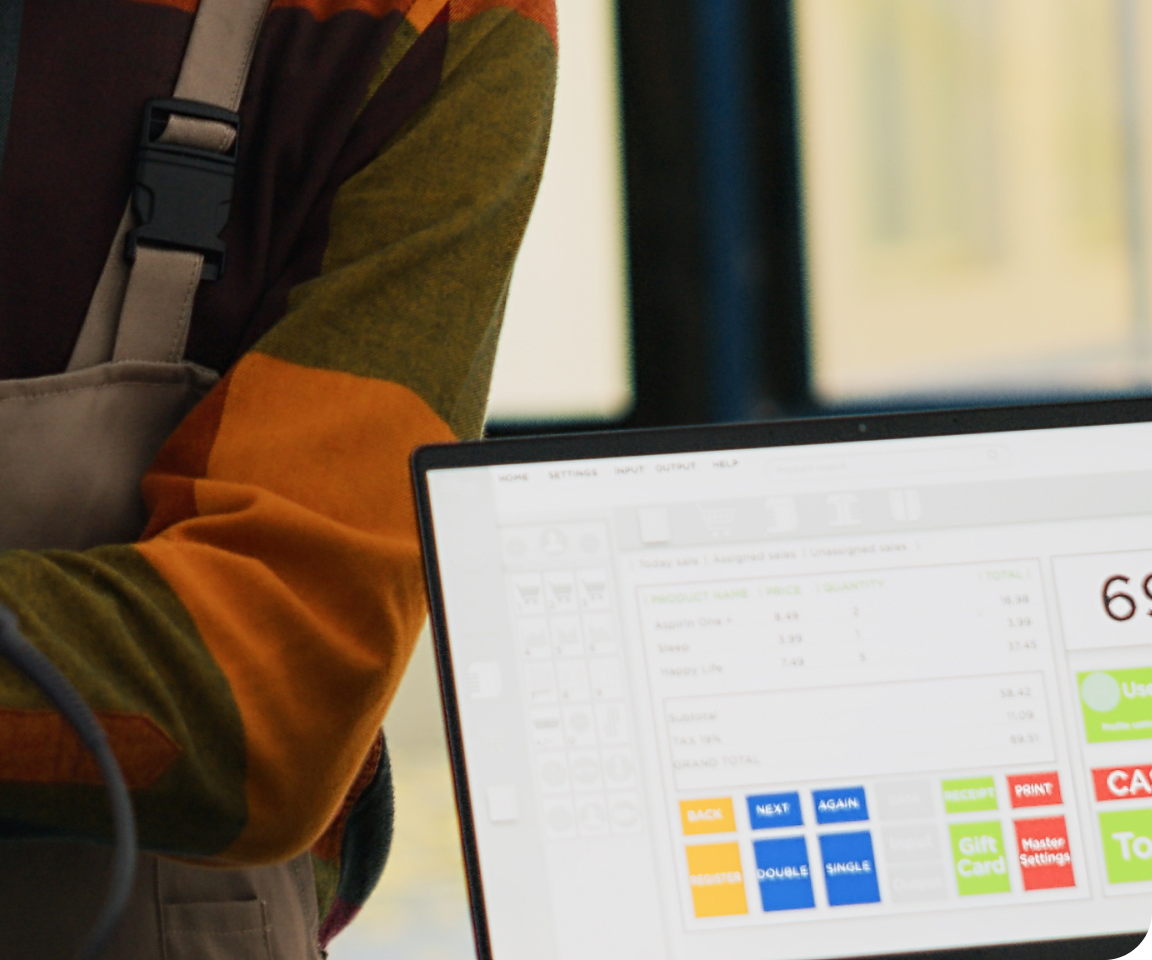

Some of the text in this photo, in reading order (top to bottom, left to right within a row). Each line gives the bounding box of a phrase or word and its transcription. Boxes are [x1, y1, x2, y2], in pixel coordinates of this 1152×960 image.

[498, 459, 738, 482] HOME SETTINGS INPUT OUTPUT HELP
[713, 552, 764, 565] Assigned
[810, 545, 875, 558] Unassigned
[650, 570, 1023, 604] PRODUCT NAME PRICE QUANTITY TOTAL
[673, 757, 717, 770] GRAND
[723, 755, 761, 766] TOTAL
[1014, 782, 1053, 797] PRINT
[1106, 768, 1152, 797] CA
[944, 787, 995, 802] RECEIPT
[756, 803, 789, 815] NEXT
[818, 797, 859, 811] AGAIN
[687, 808, 723, 823] BACK
[958, 834, 997, 856] Gift
[1021, 835, 1066, 852] Master
[825, 860, 871, 874] SINGLE
[957, 856, 1006, 878] Card
[1019, 851, 1071, 868] Settings
[689, 871, 742, 886] REGISTER
[756, 864, 809, 879] DOUBLE
